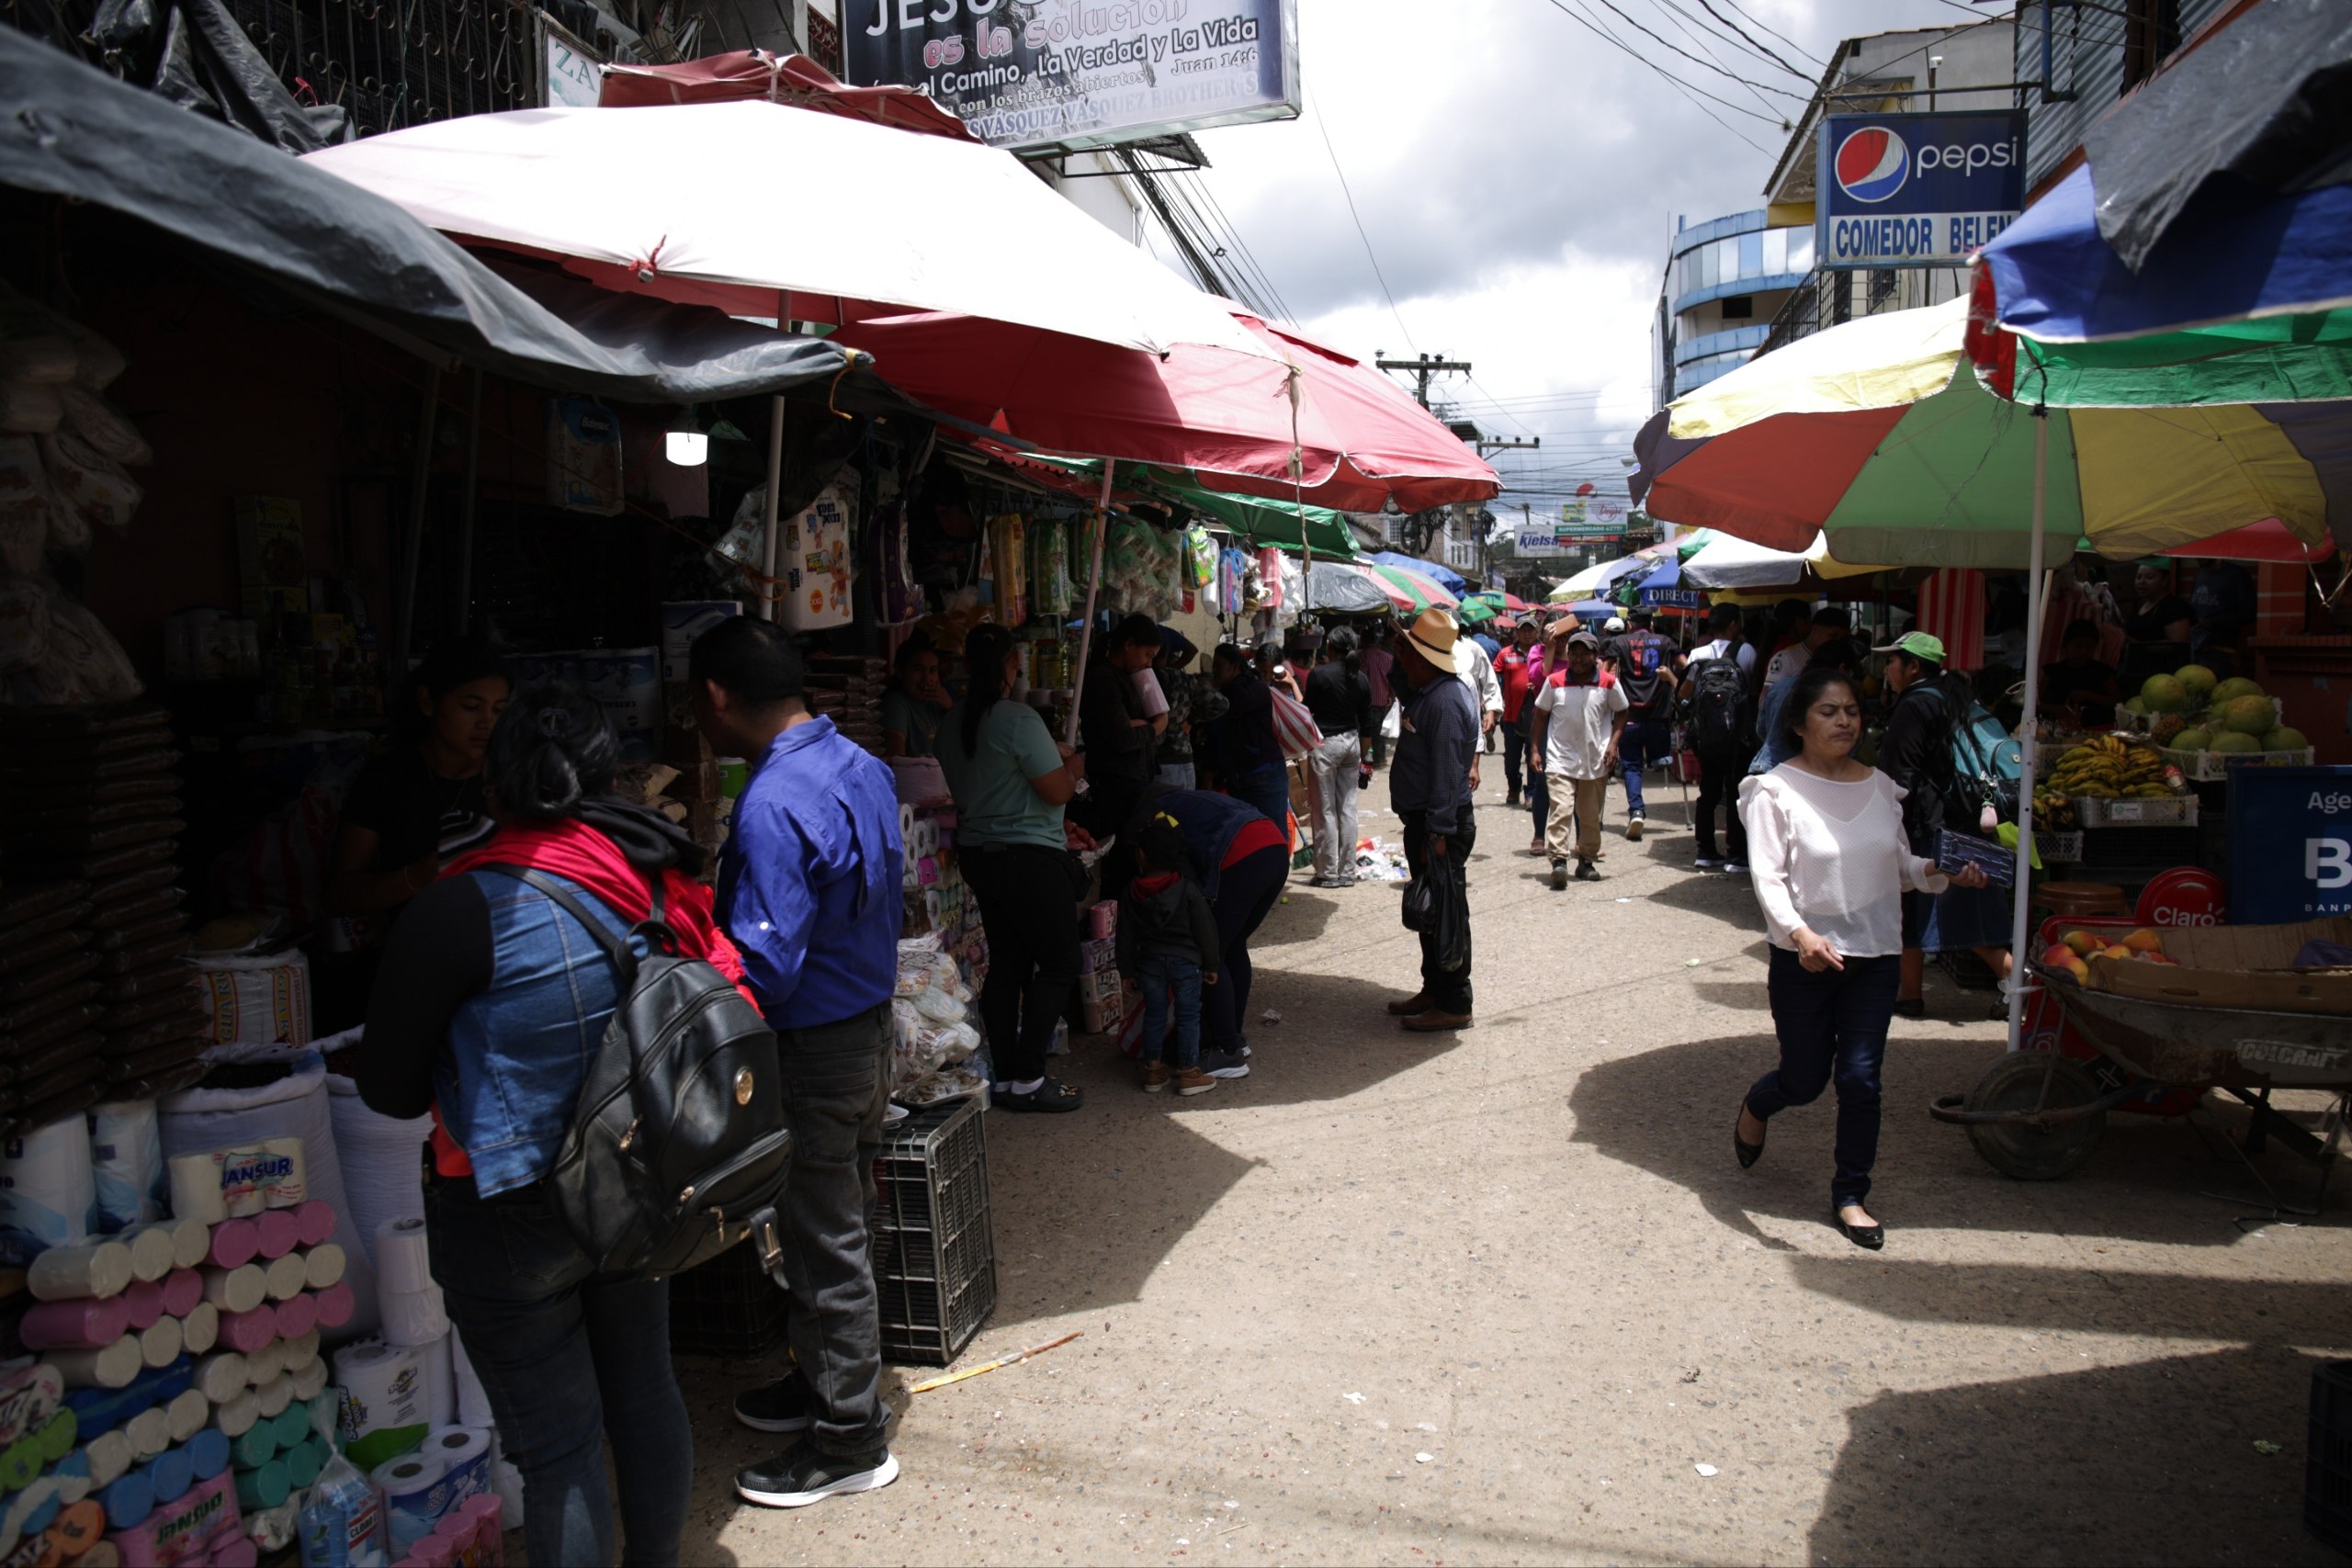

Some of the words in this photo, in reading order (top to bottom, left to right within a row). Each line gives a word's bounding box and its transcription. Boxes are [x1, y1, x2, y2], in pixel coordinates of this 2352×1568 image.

[923, 35, 965, 69] es
[976, 17, 1012, 59] la
[941, 63, 1026, 94] Camino,
[1037, 53, 1063, 77] La
[1066, 34, 1148, 72] Verdad
[1151, 36, 1168, 62] y
[1171, 28, 1199, 54] La
[1202, 15, 1259, 47] Vida
[1170, 56, 1217, 76] Juan
[1220, 48, 1260, 68] 14:6
[958, 99, 987, 114] con
[990, 94, 1013, 108] los
[1017, 84, 1071, 103] brazos
[1075, 71, 1146, 93] abiertos
[980, 104, 1062, 139] VÁSQUEZ
[1063, 93, 1145, 124] VÁSQUEZ
[1917, 136, 2018, 178] pepsi
[1836, 217, 1932, 257] COMEDOR
[1519, 535, 1559, 549] Kielsa
[2307, 791, 2352, 815] Age
[2304, 838, 2352, 888] B
[2154, 905, 2217, 926] Claro
[2304, 904, 2352, 912] BANP
[221, 1156, 294, 1190] JANSUR
